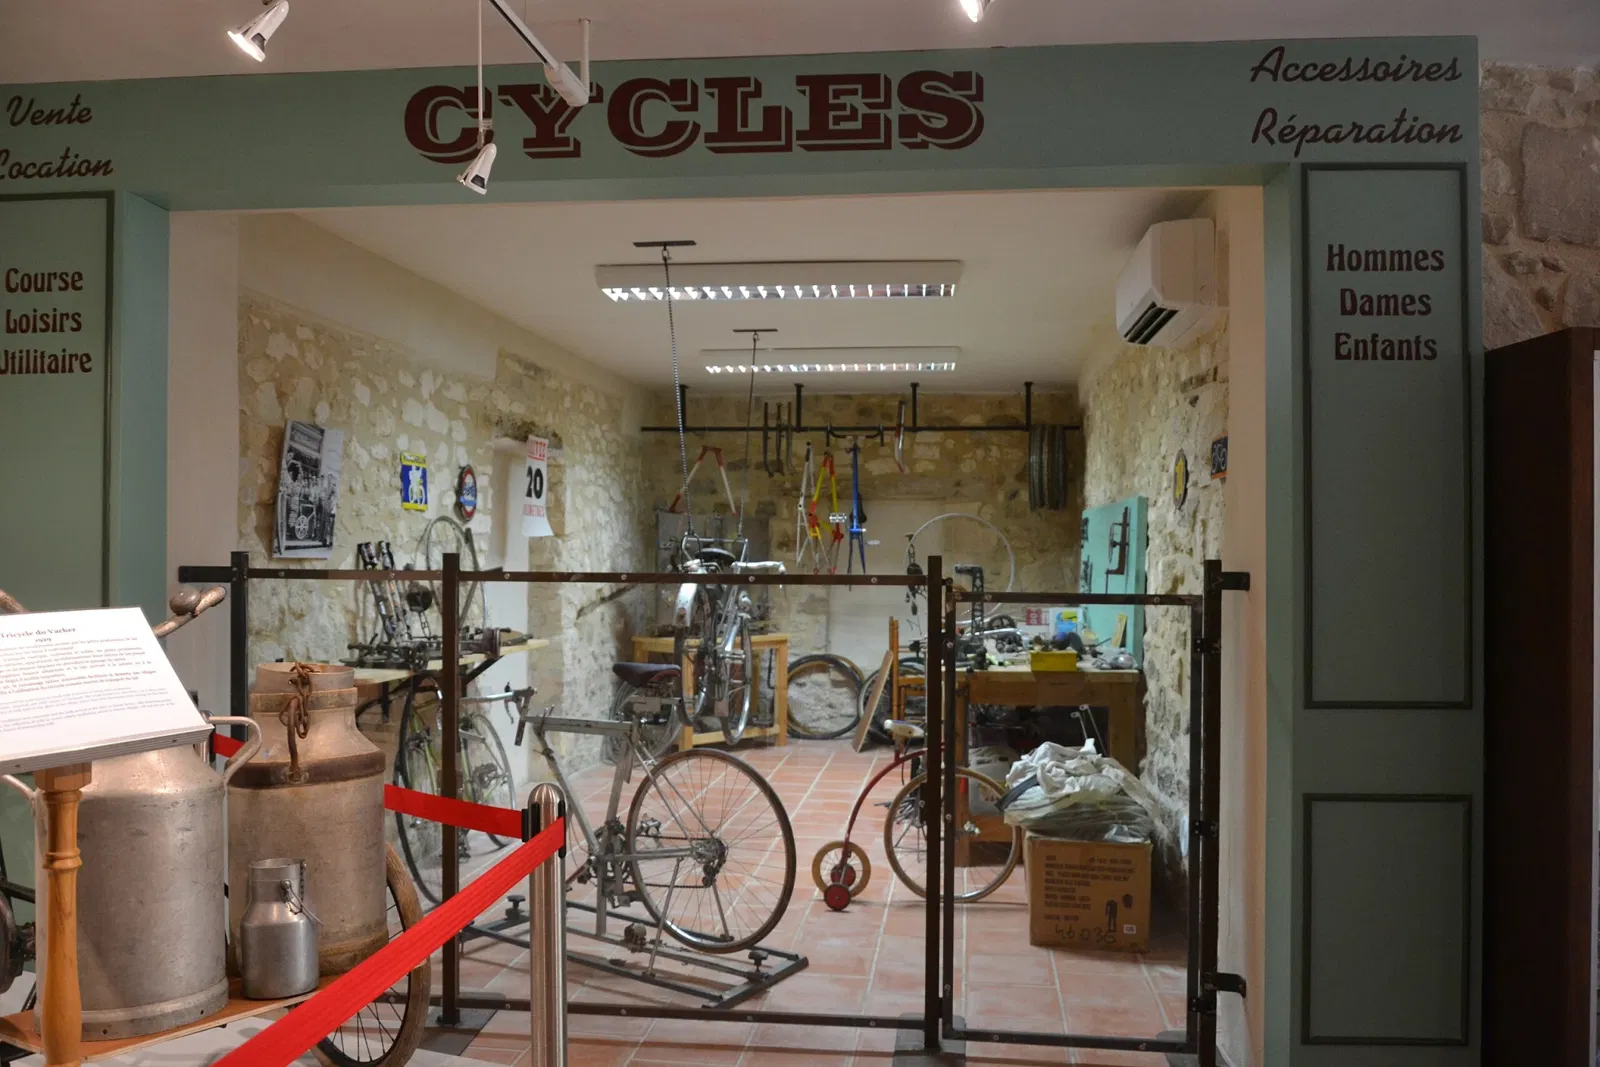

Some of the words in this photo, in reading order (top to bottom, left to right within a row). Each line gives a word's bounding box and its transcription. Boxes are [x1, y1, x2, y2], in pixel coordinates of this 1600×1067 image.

[1250, 46, 1462, 82] Accessoires
[6, 93, 93, 127] Vente
[404, 69, 984, 164] CYCLES
[1251, 107, 1463, 158] Réparation
[1327, 243, 1445, 272] Hommes
[5, 267, 84, 293] Course
[1340, 288, 1432, 316] Dames
[5, 307, 82, 334] Loisirs
[1335, 332, 1437, 361] Enfants
[525, 465, 544, 499] 20
